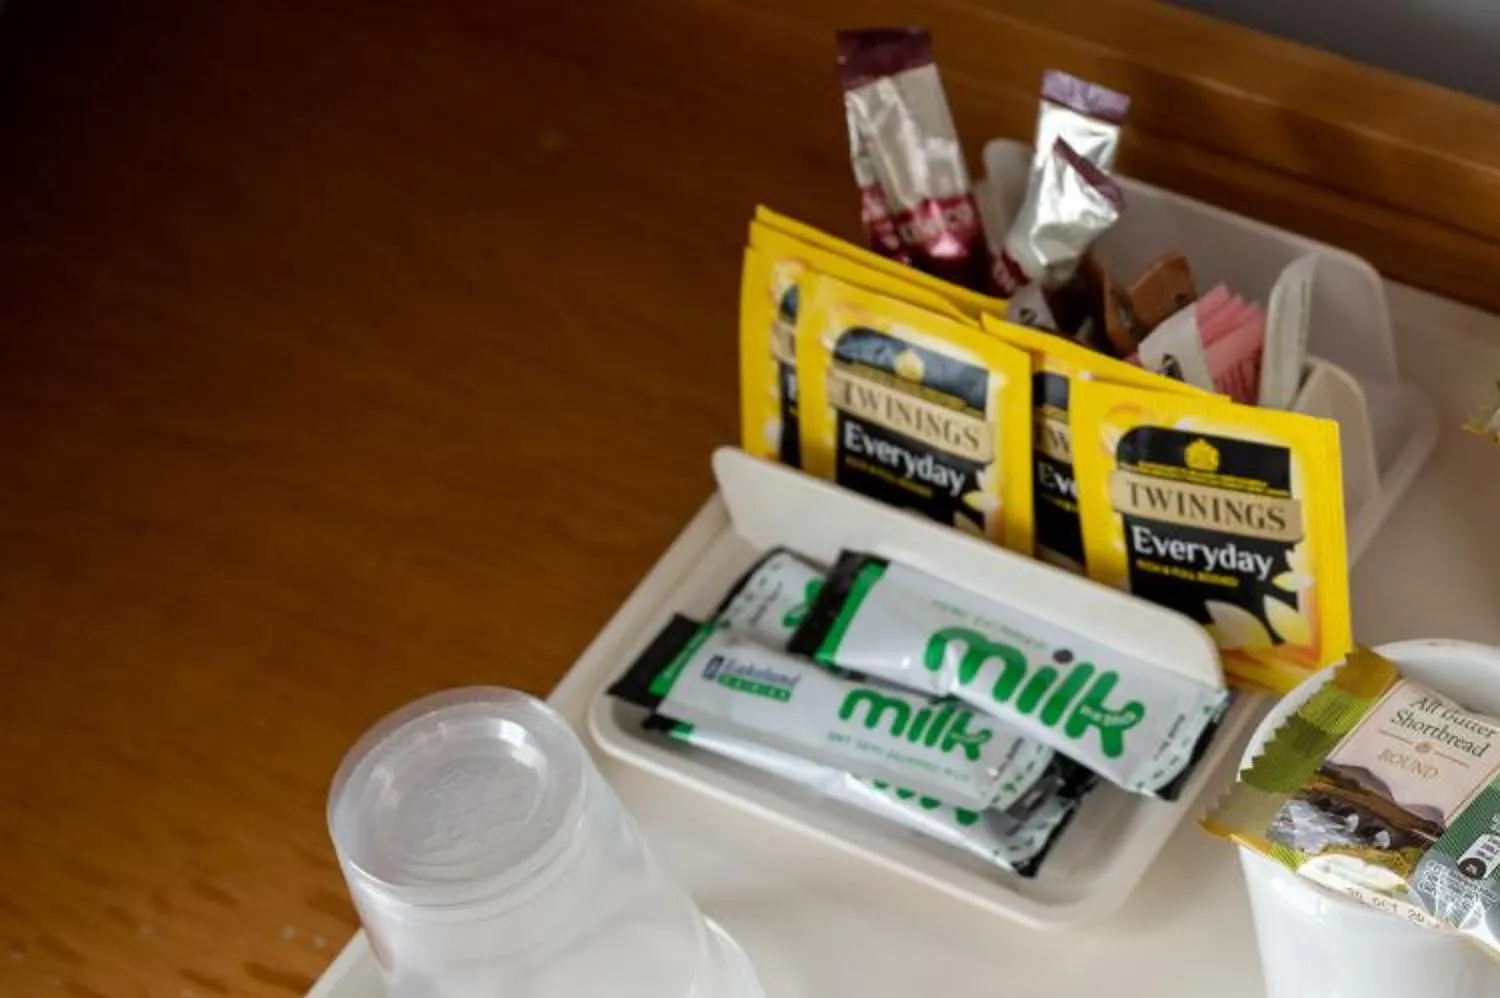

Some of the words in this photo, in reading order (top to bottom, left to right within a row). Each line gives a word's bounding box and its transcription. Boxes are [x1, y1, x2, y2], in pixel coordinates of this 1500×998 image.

[843, 380, 980, 449] TWININGS
[844, 421, 966, 497] Everyday
[1126, 481, 1286, 531] TWININGS
[1131, 525, 1274, 581] Everyday
[924, 626, 1145, 759] milk
[839, 688, 993, 761] milk
[1391, 709, 1491, 758] Shortbread
[1378, 748, 1439, 778] ROUND
